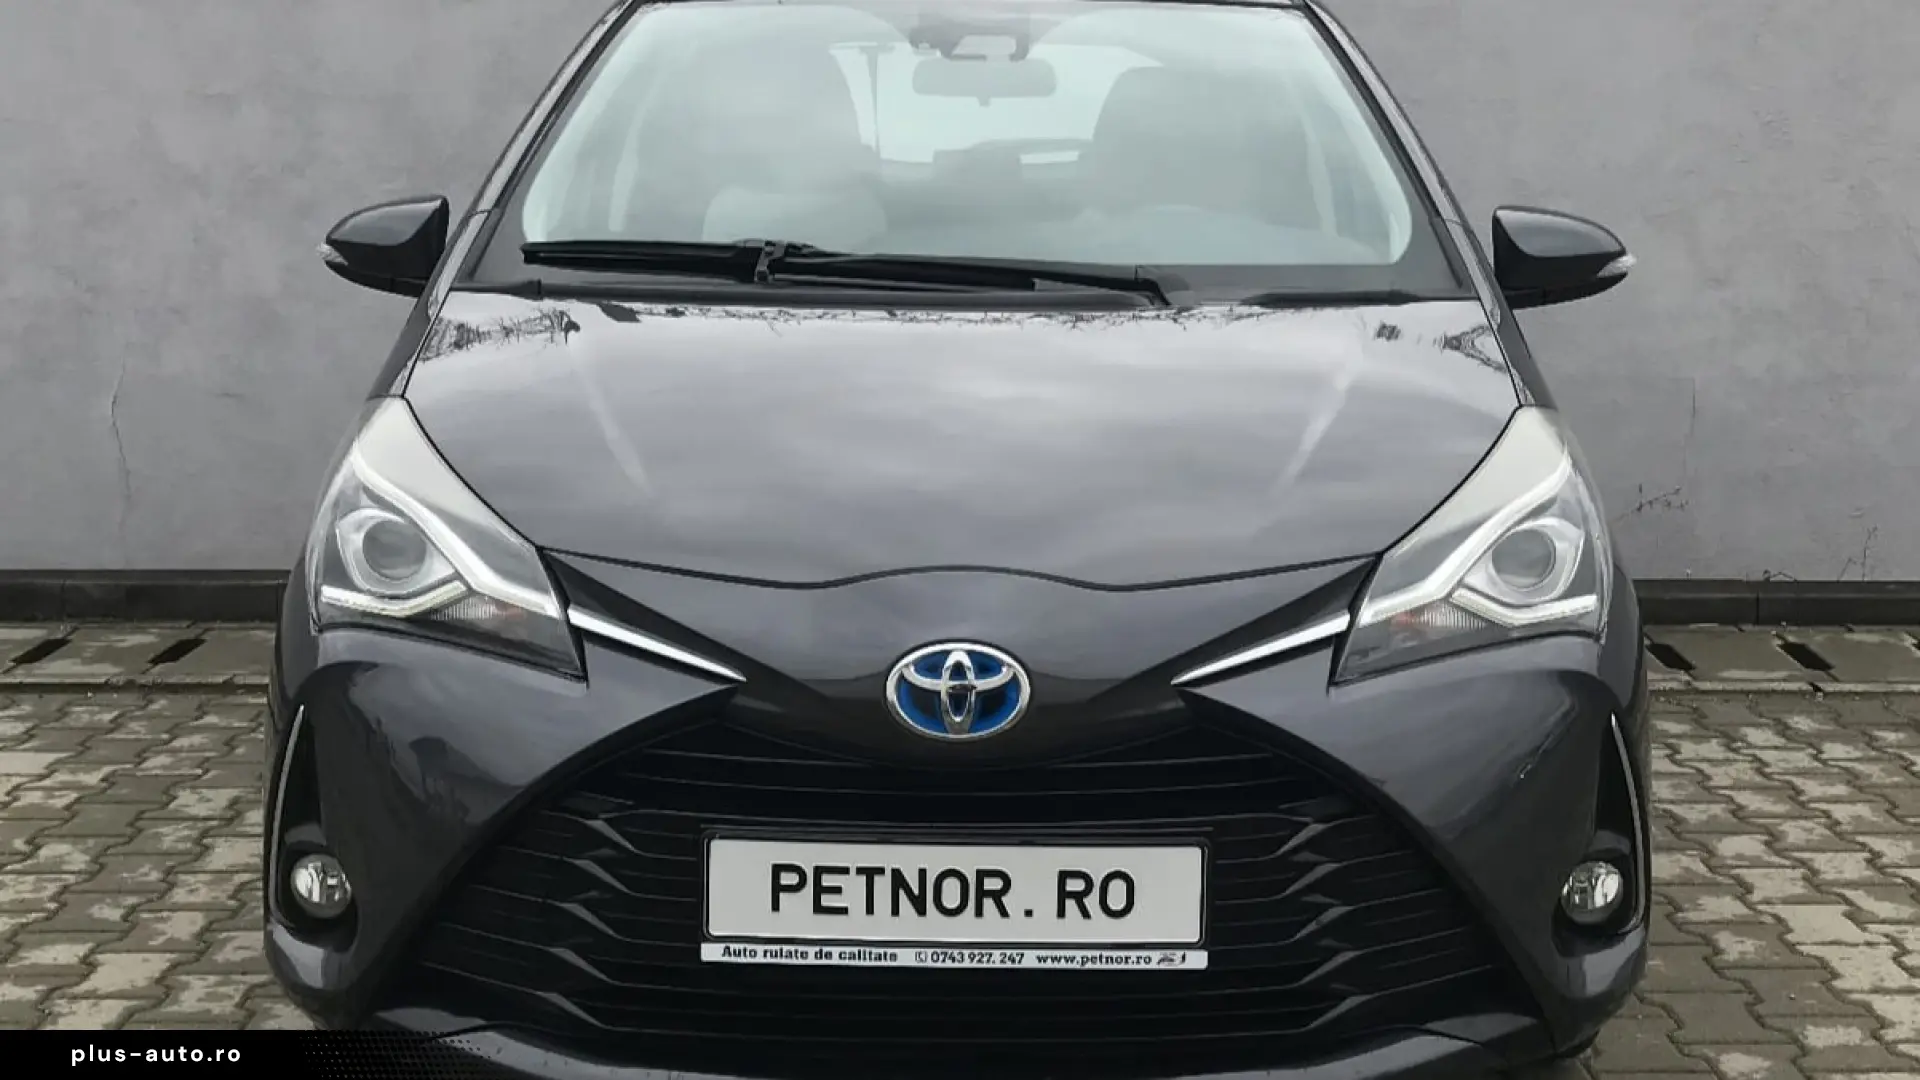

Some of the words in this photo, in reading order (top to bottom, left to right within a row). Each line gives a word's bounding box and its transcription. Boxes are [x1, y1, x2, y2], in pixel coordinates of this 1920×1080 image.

[722, 945, 757, 958] Auto
[763, 946, 808, 960] rulate
[814, 947, 833, 961] de
[838, 948, 898, 962] calitate
[930, 951, 964, 965] 0743
[1036, 952, 1152, 966] www.petnor.ro
